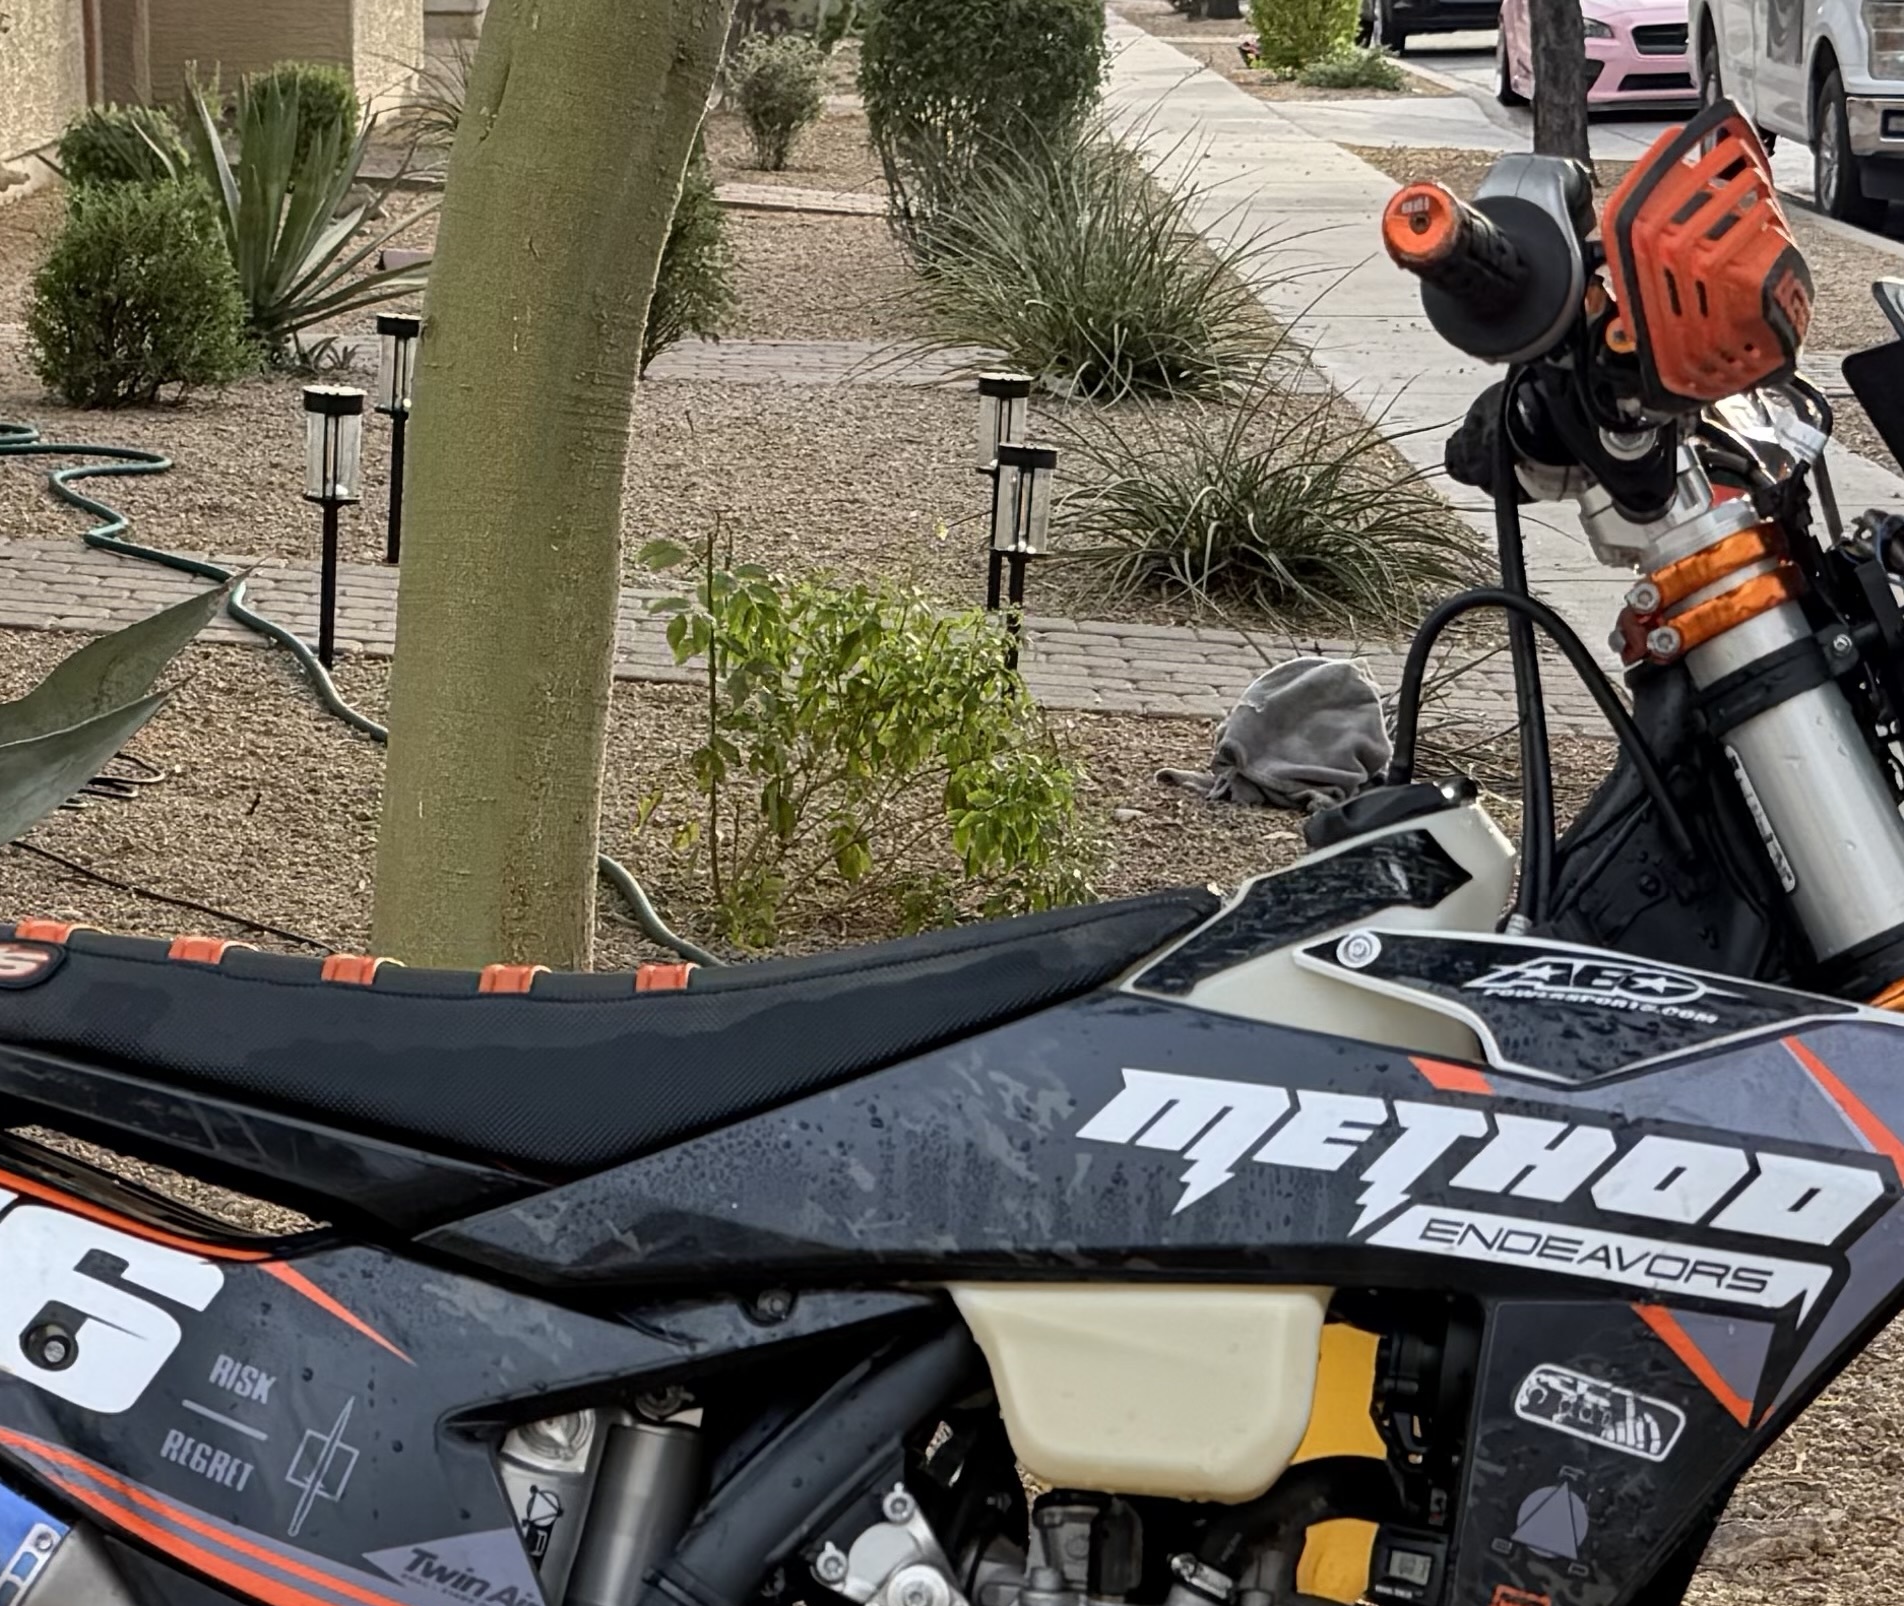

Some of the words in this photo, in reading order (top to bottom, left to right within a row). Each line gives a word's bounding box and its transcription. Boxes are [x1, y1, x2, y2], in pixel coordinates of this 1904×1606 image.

[1075, 1068, 1888, 1247] METHOD
[1419, 1218, 1774, 1294] ENDEAVORS
[208, 1354, 277, 1405] RISK
[160, 1429, 255, 1492] REGRET
[404, 1547, 491, 1598] Twin
